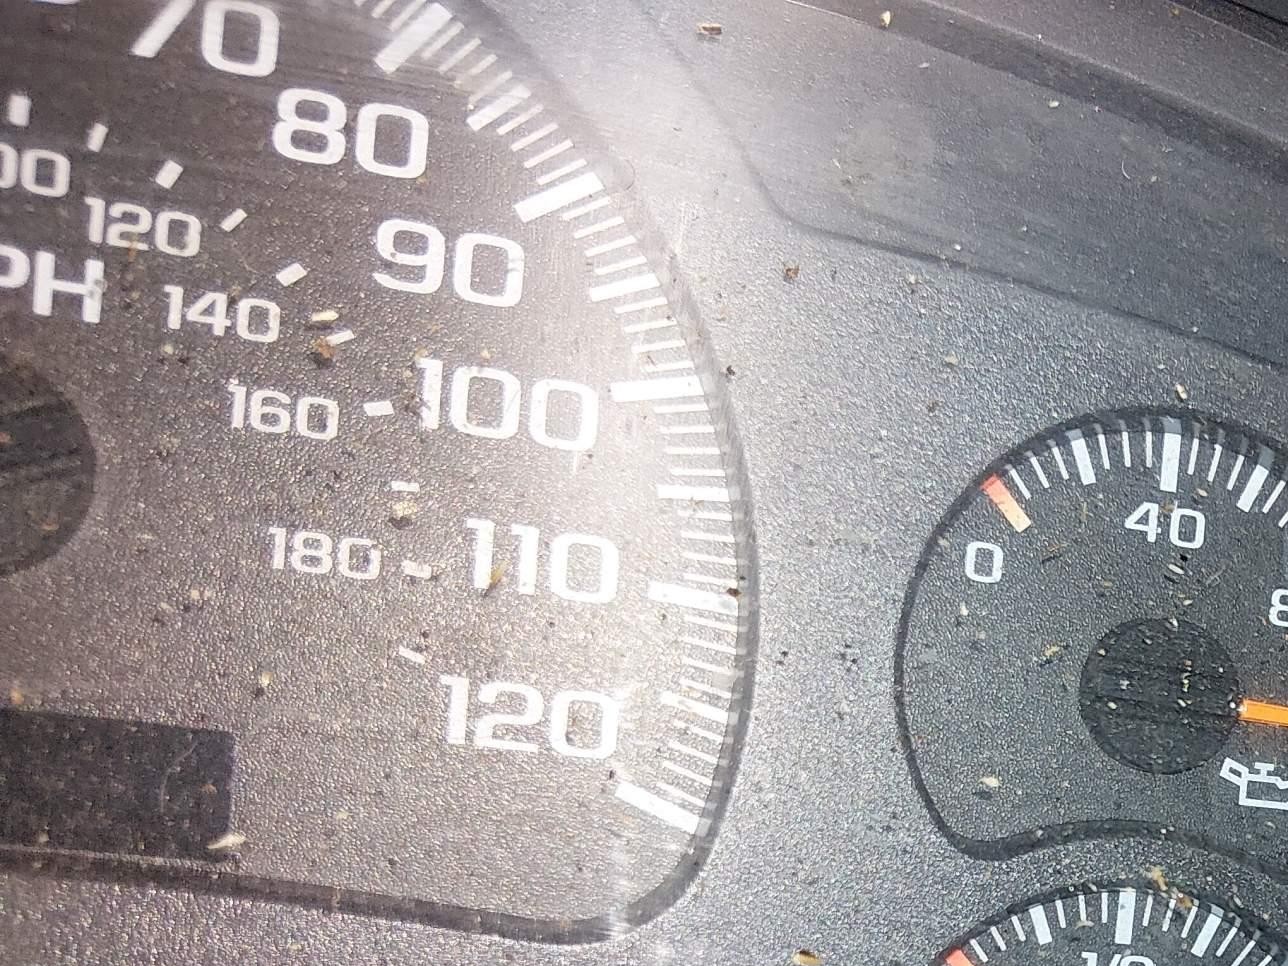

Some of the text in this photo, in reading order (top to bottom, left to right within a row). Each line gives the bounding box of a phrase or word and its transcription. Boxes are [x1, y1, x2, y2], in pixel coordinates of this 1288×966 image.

[272, 88, 429, 178] 80
[84, 196, 202, 257] 120
[372, 218, 525, 306] 90
[163, 284, 281, 343] 140
[229, 381, 339, 440] 160
[416, 358, 599, 451] 100
[267, 526, 381, 580] 180
[1124, 502, 1205, 549] 40
[465, 518, 620, 601] 110
[964, 541, 1004, 583] 0
[439, 675, 626, 760] 120
